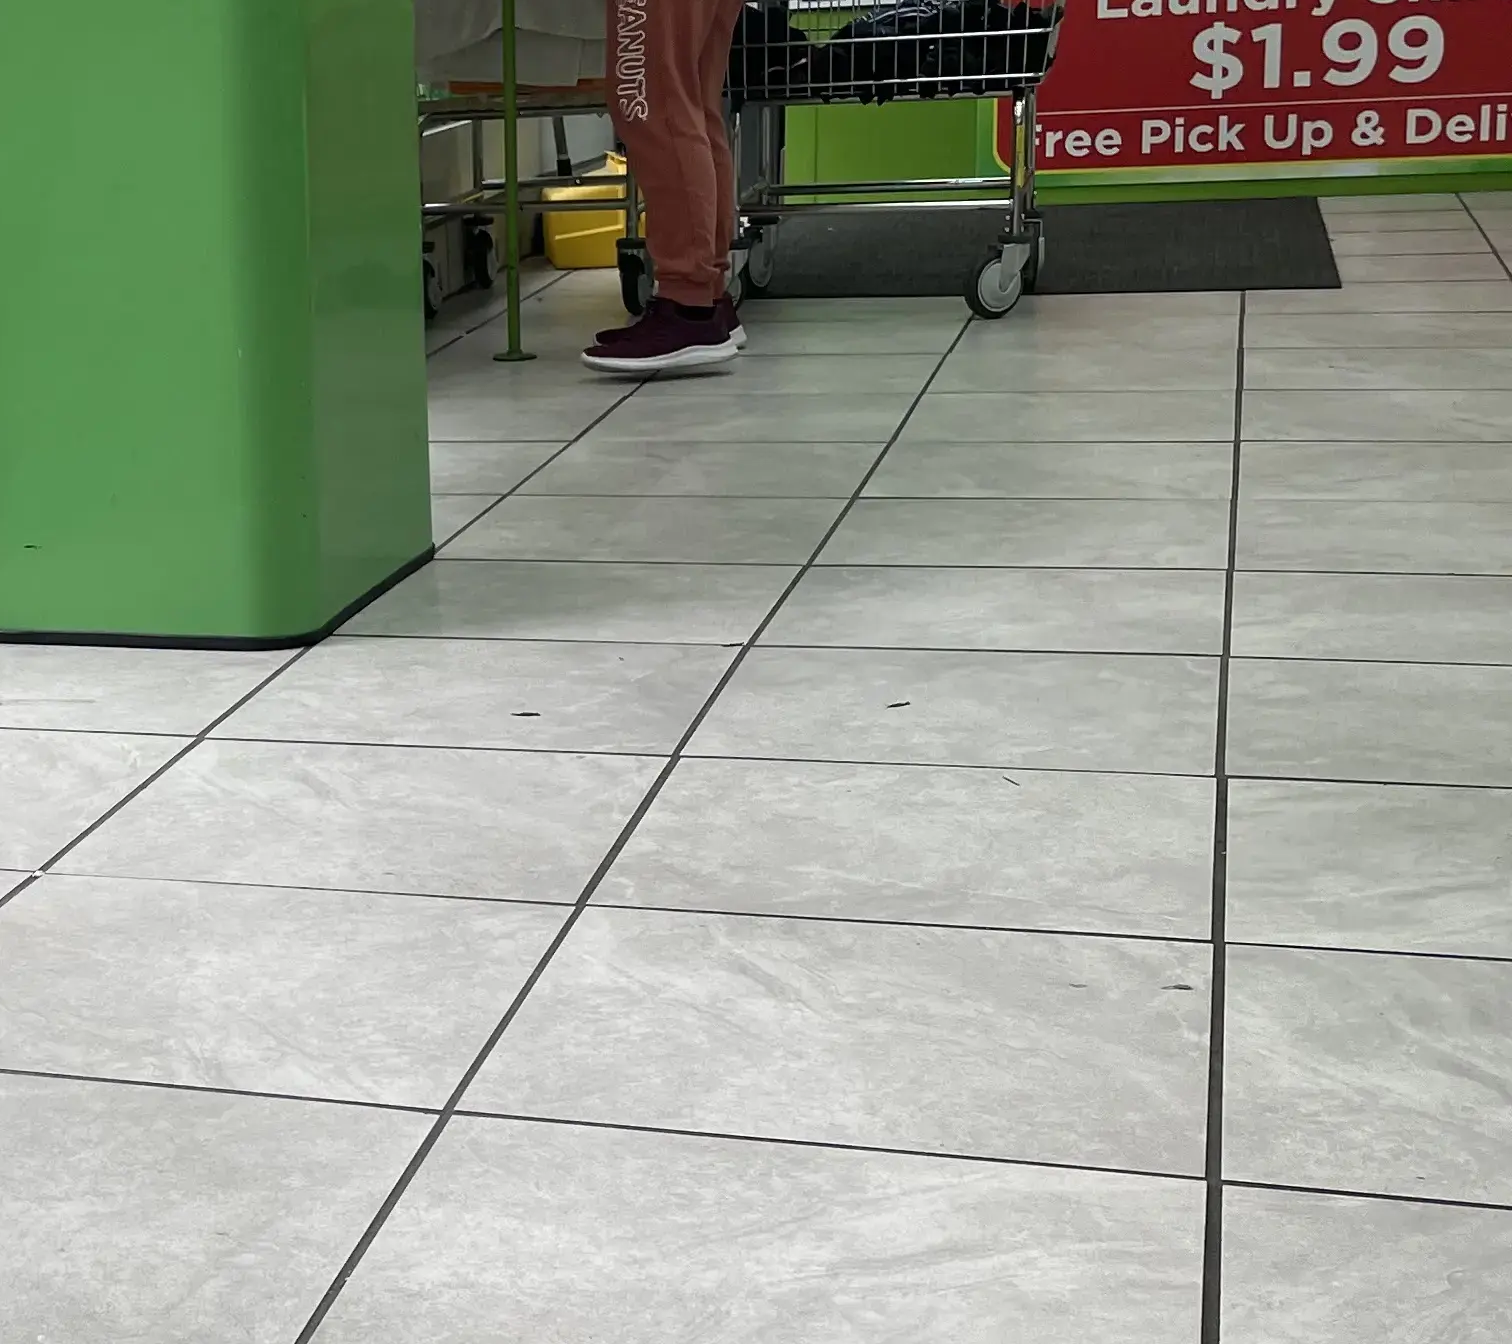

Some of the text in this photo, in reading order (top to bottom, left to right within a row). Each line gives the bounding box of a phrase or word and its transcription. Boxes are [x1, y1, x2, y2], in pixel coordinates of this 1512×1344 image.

[1189, 15, 1445, 100] $1.99
[1141, 115, 1246, 154] Pick
[1263, 113, 1334, 155] Up
[1350, 110, 1385, 146] &
[1406, 104, 1512, 145] Deli
